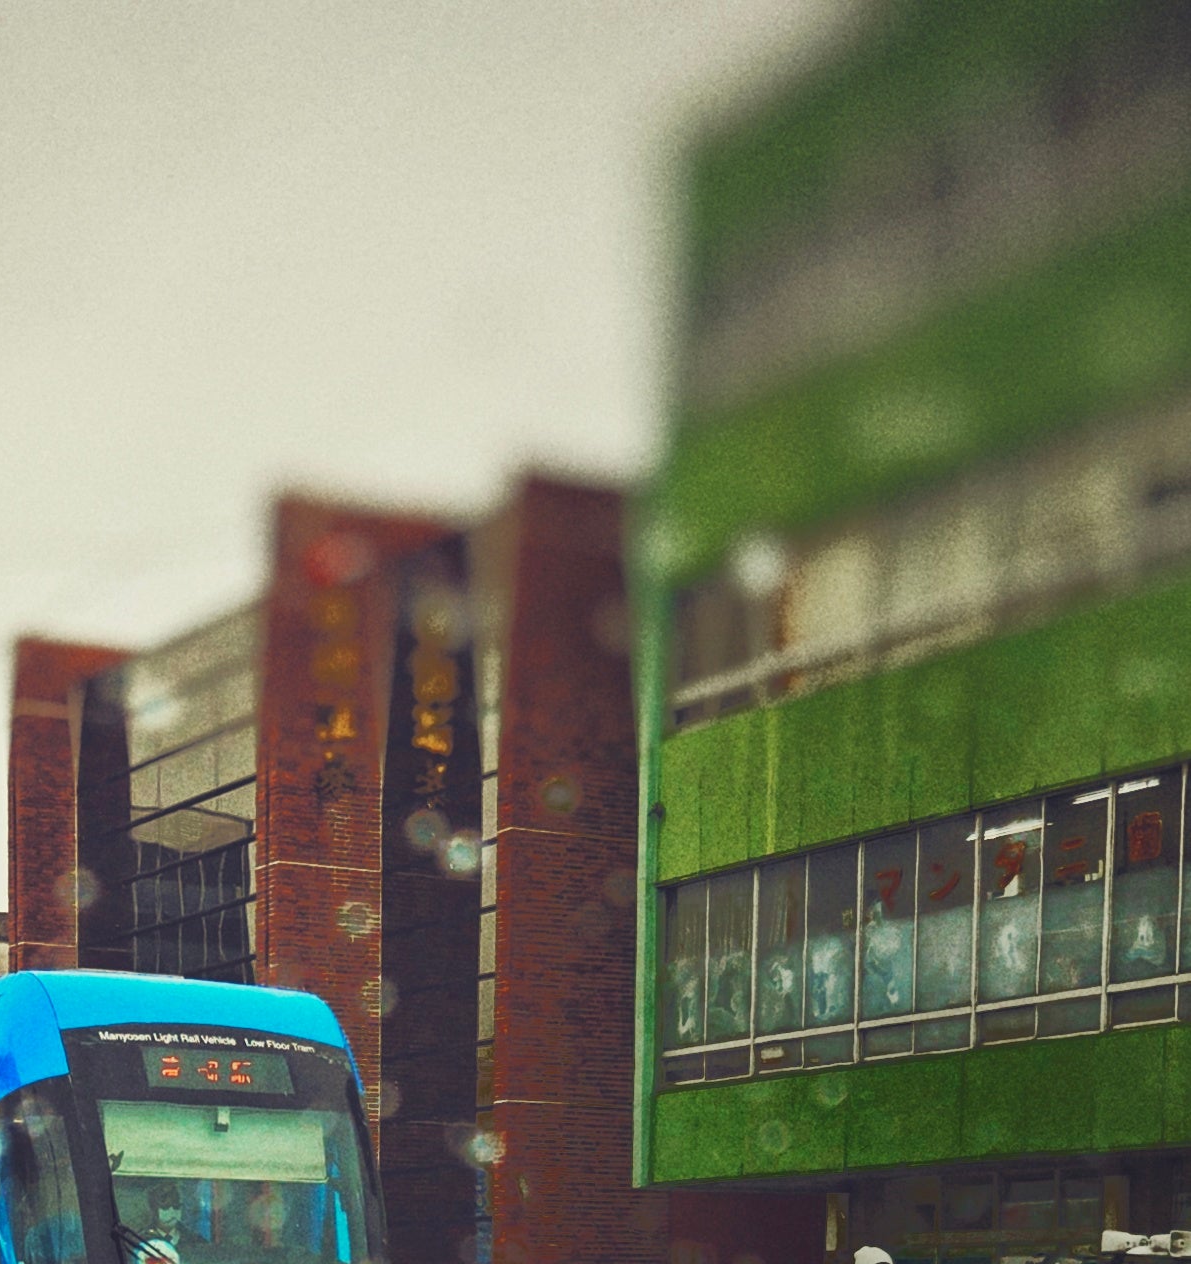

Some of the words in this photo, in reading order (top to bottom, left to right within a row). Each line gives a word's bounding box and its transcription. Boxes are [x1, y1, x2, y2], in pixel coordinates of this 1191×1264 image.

[98, 1031, 152, 1043] Manyosen
[153, 1032, 179, 1044] Light
[181, 1033, 200, 1044] Rail
[201, 1034, 237, 1046] Vehicle
[244, 1038, 265, 1048] Low
[266, 1039, 291, 1051] Floor
[292, 1042, 315, 1053] Tram
